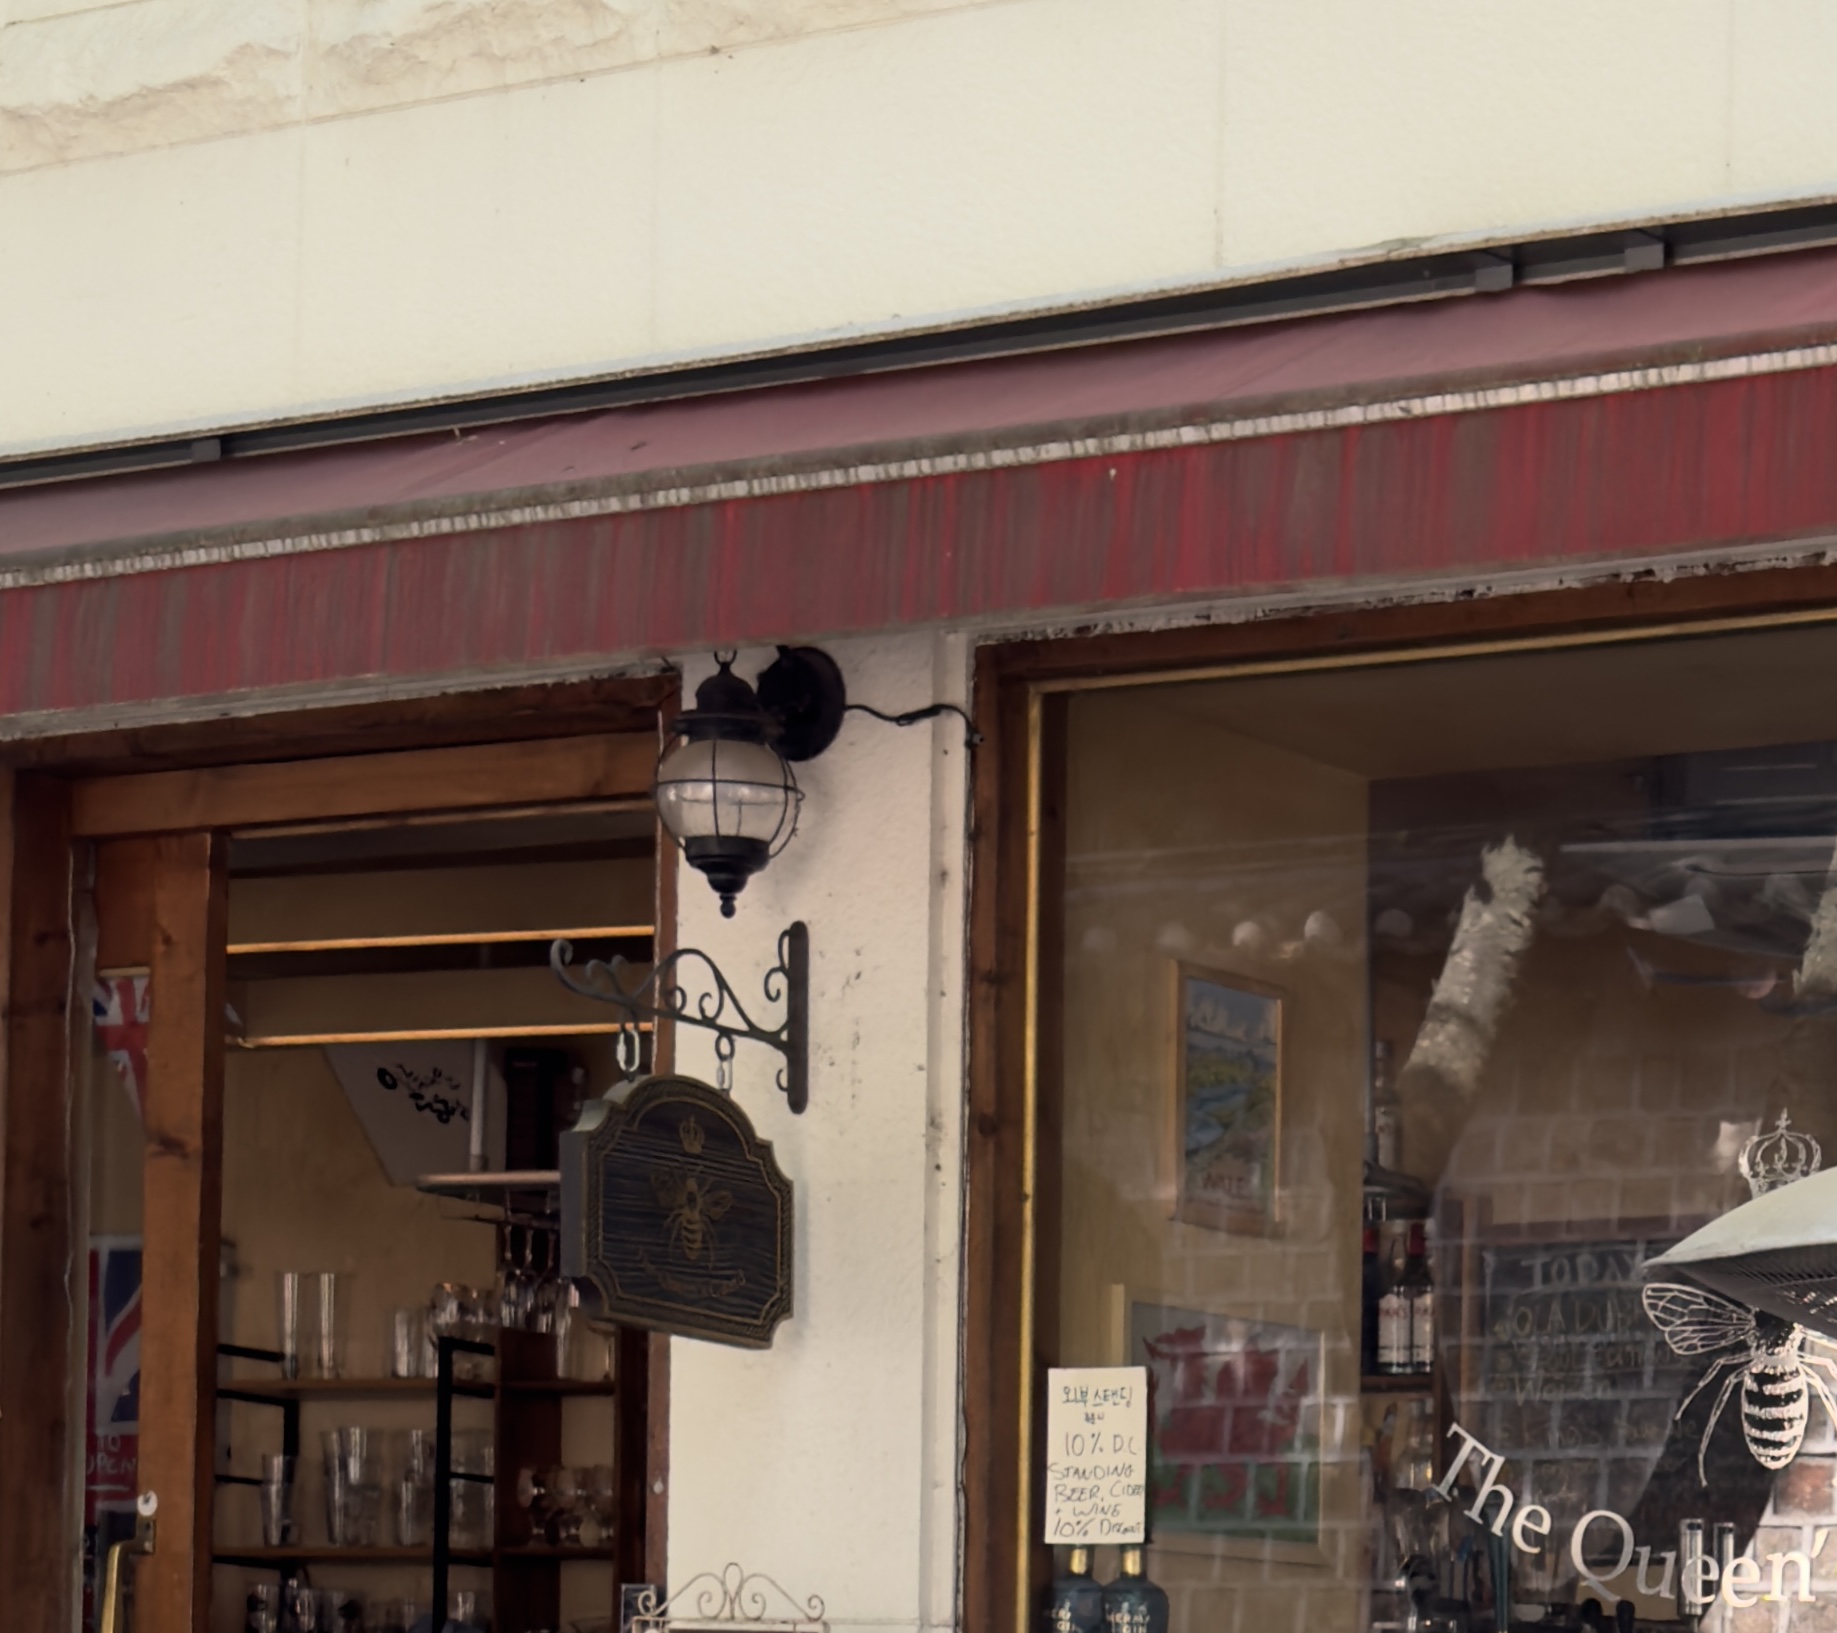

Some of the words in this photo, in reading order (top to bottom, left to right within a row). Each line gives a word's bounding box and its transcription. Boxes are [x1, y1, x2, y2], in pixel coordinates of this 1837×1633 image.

[1065, 1432, 1104, 1456] 10%
[1049, 1462, 1134, 1482] STANDING
[1428, 1423, 1552, 1554] The
[1073, 1502, 1122, 1518] WINE
[1053, 1518, 1097, 1538] 10%
